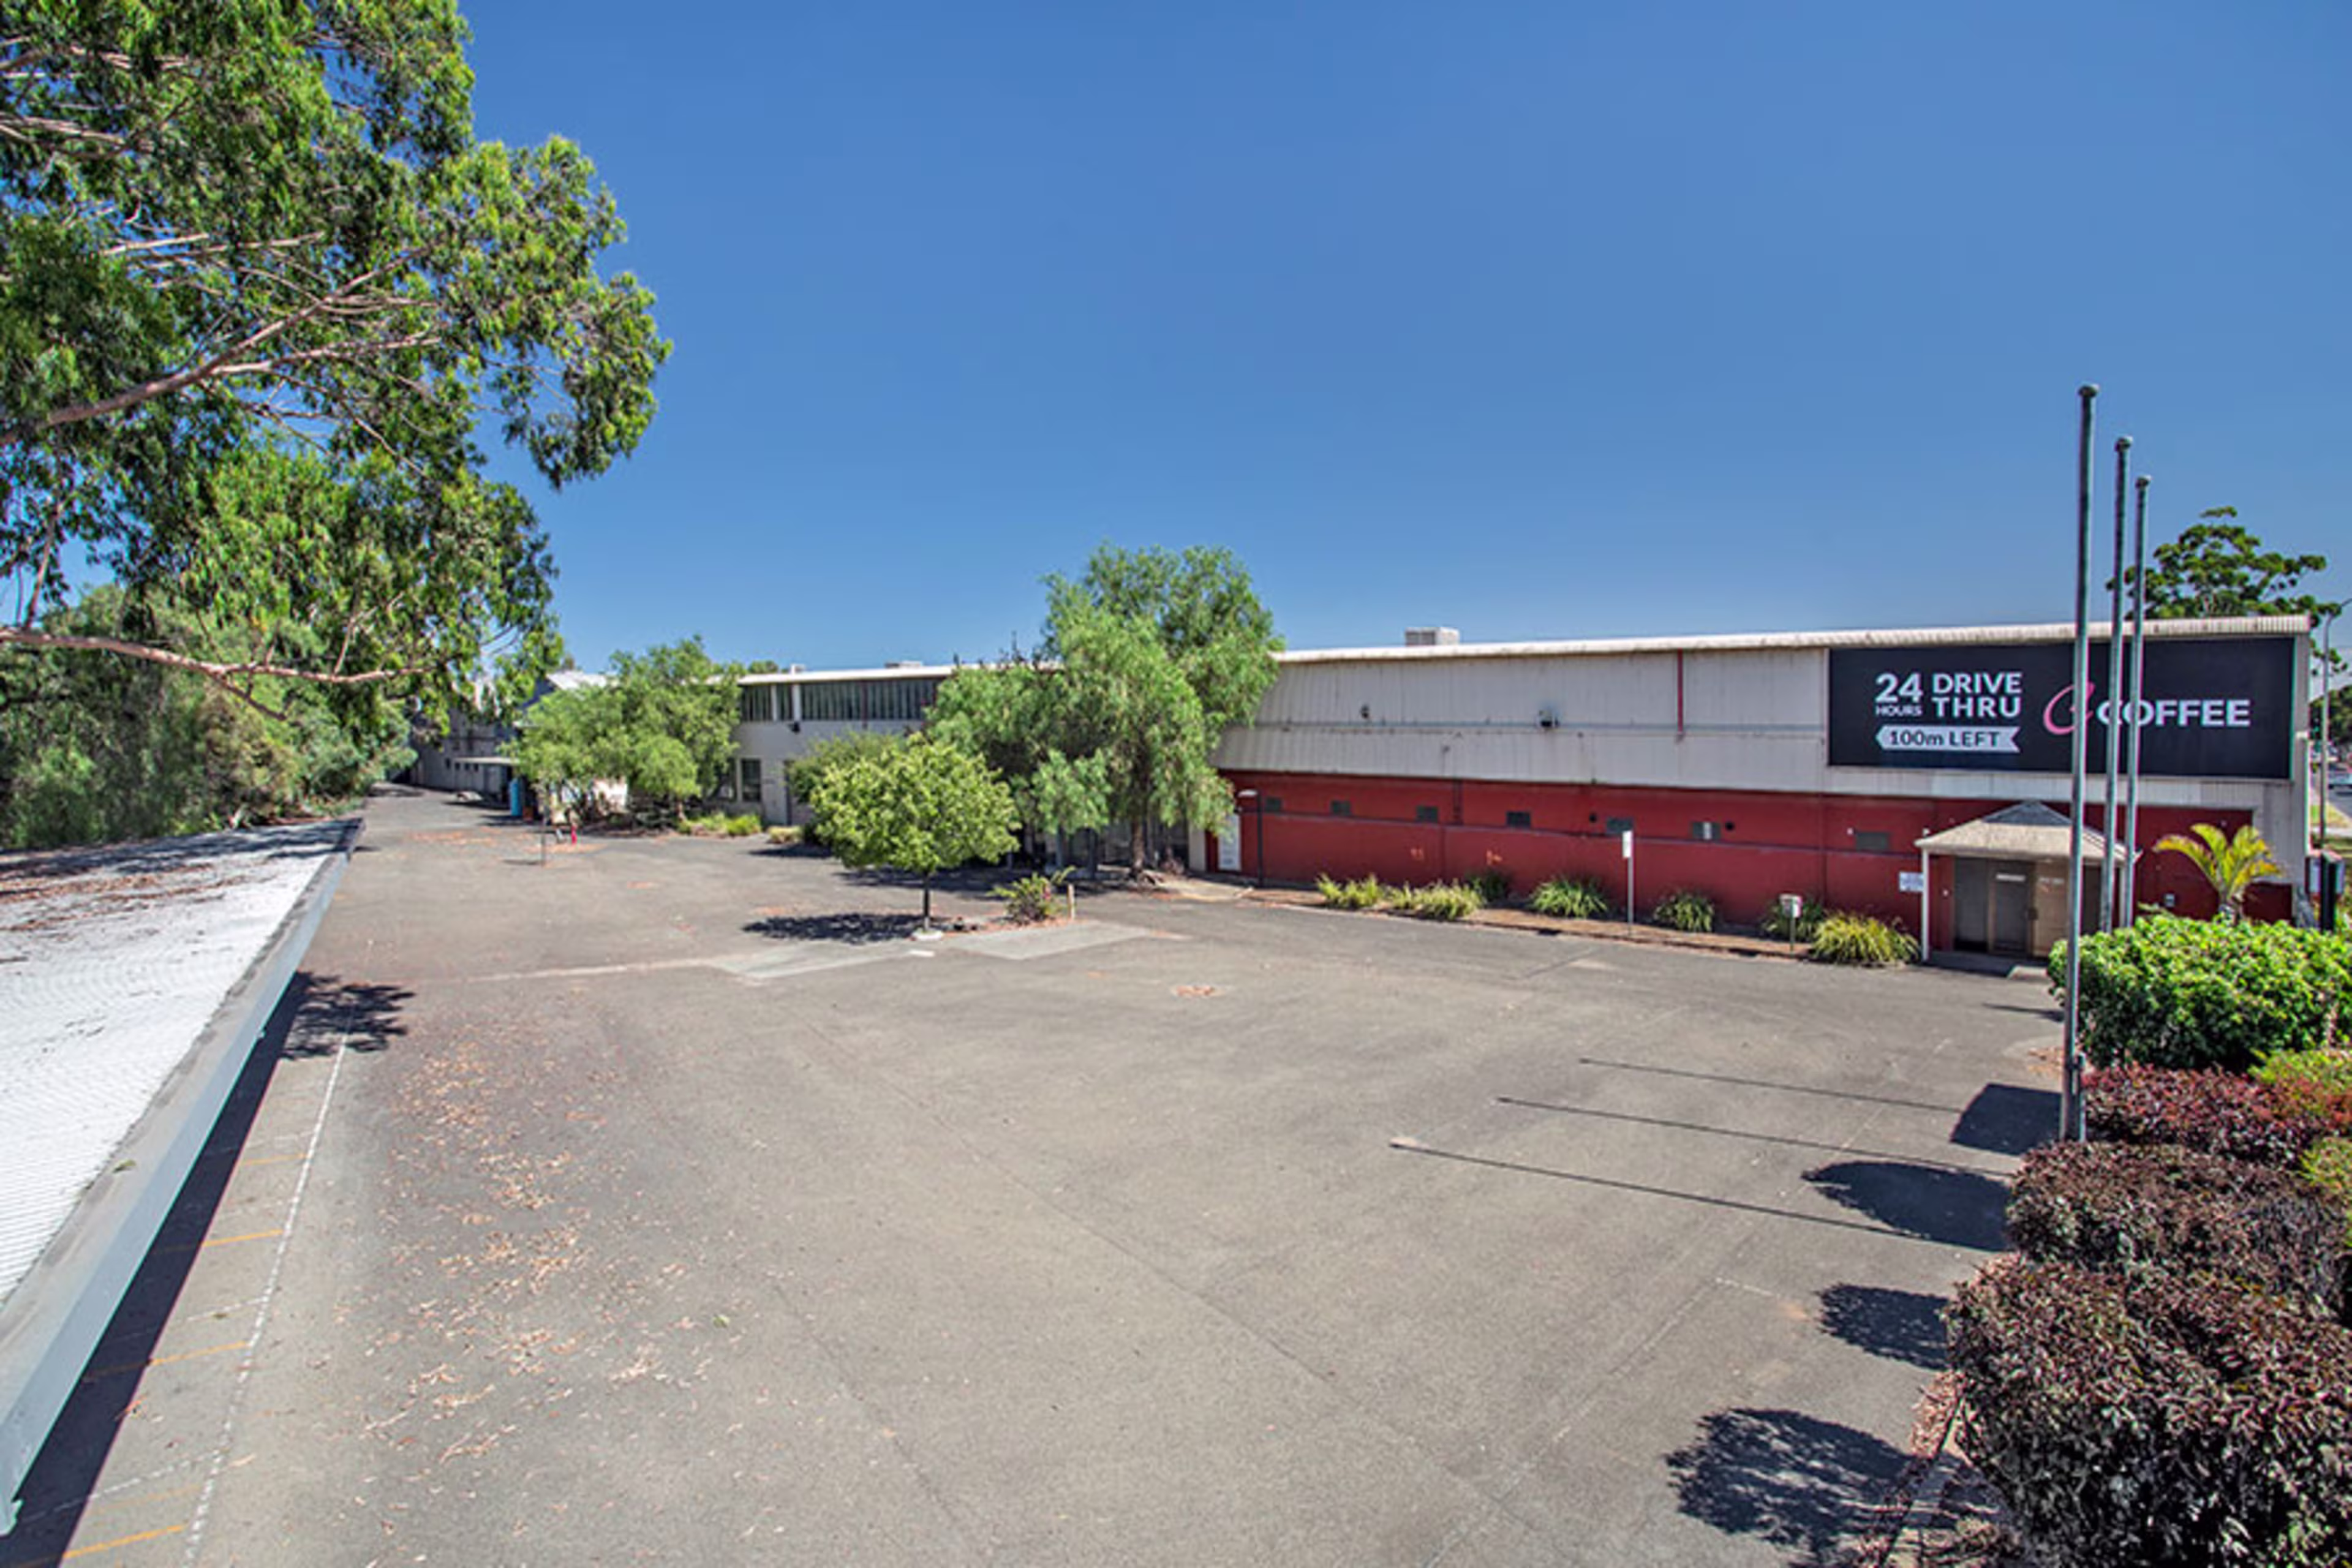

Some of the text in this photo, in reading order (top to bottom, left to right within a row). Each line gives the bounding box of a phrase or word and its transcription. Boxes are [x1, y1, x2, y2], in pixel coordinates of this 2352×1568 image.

[1875, 672, 1923, 703] 24
[1932, 672, 2022, 694] DRIVE
[1875, 705, 1923, 716] HOURS
[1931, 696, 2022, 717] THRU
[1890, 731, 2000, 747] 100m LEFT
